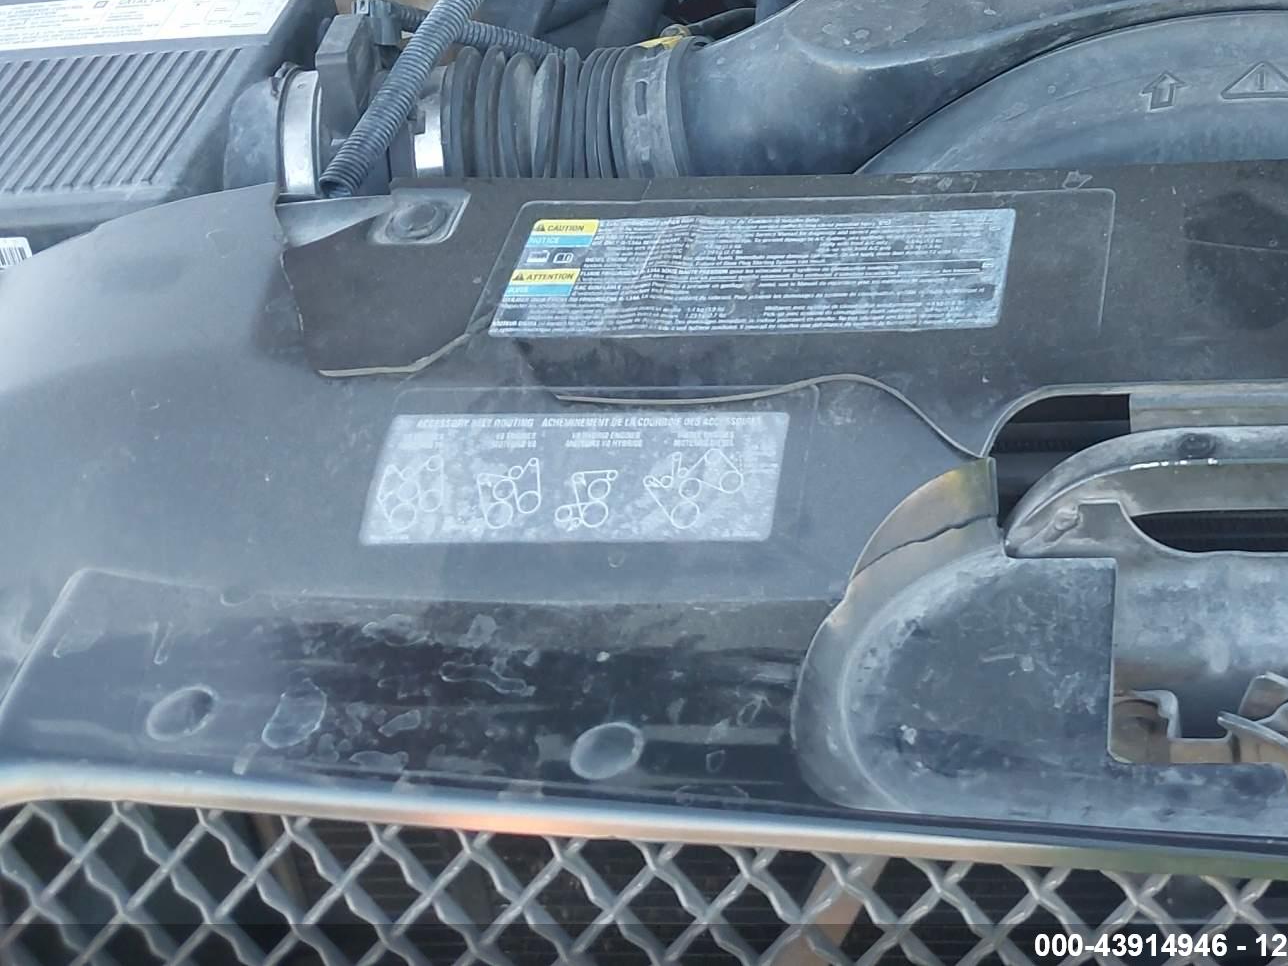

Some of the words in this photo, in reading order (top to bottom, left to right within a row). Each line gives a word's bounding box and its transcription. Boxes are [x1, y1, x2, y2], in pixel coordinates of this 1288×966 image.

[526, 273, 574, 281] ATTENTION
[494, 418, 534, 427] ROUTING
[611, 418, 623, 427] DE
